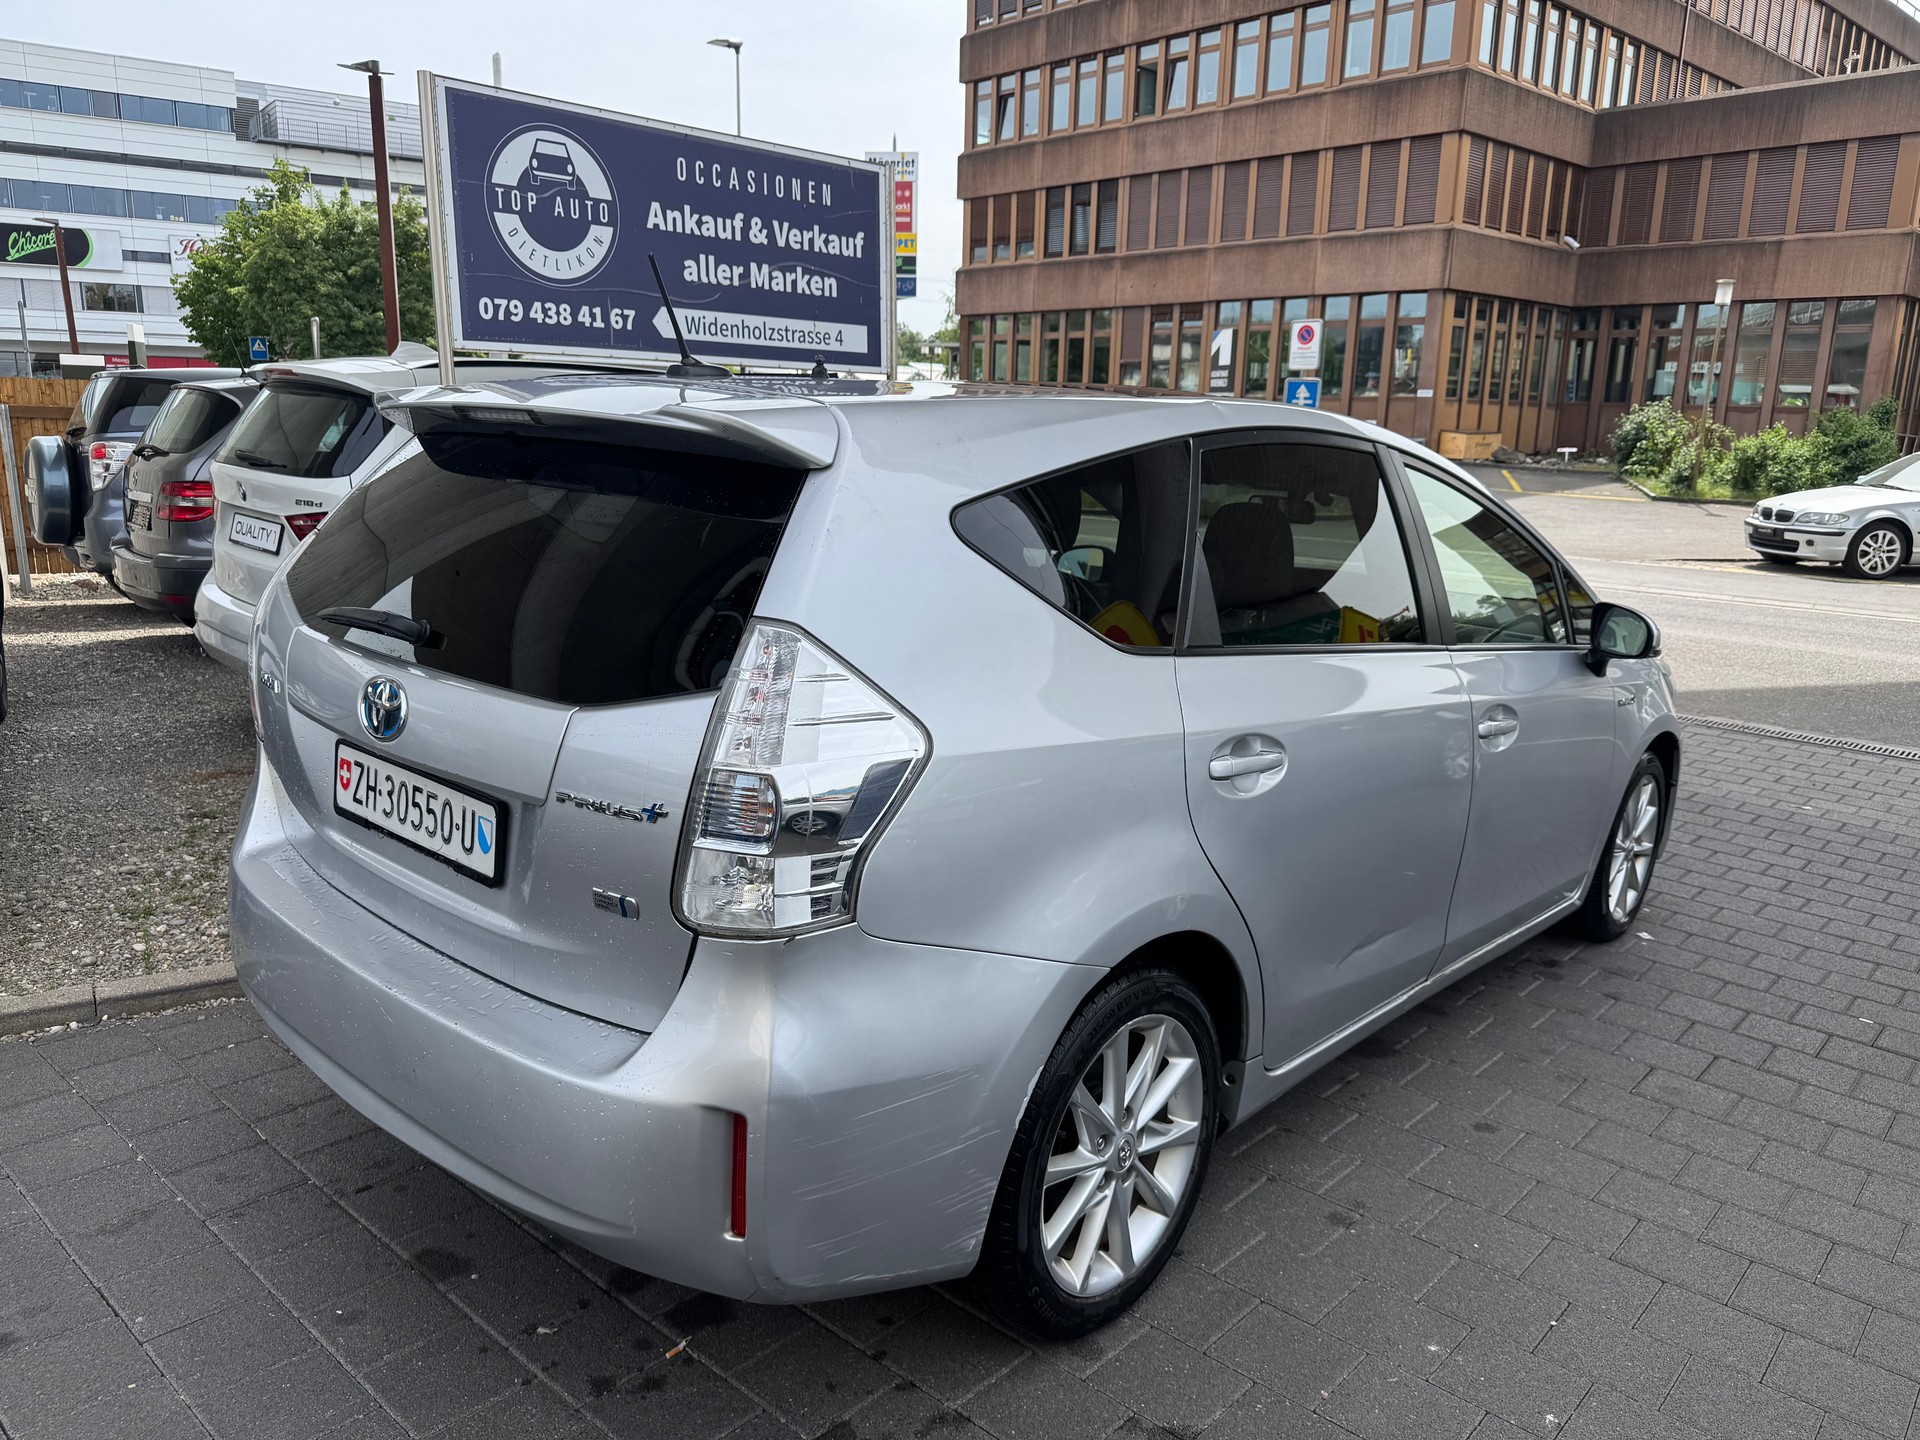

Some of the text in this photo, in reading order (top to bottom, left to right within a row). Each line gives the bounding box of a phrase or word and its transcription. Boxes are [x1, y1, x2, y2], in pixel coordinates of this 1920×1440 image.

[676, 157, 831, 207] OCCASIONEN
[495, 187, 608, 223] TOP AUTO
[507, 227, 604, 272] DIETLIKON
[647, 201, 865, 258] Ankauf & Verkauf
[683, 253, 838, 297] aller Marken
[478, 297, 636, 330] 079 438 41 67
[684, 315, 844, 346] Widenholzstrasse 4
